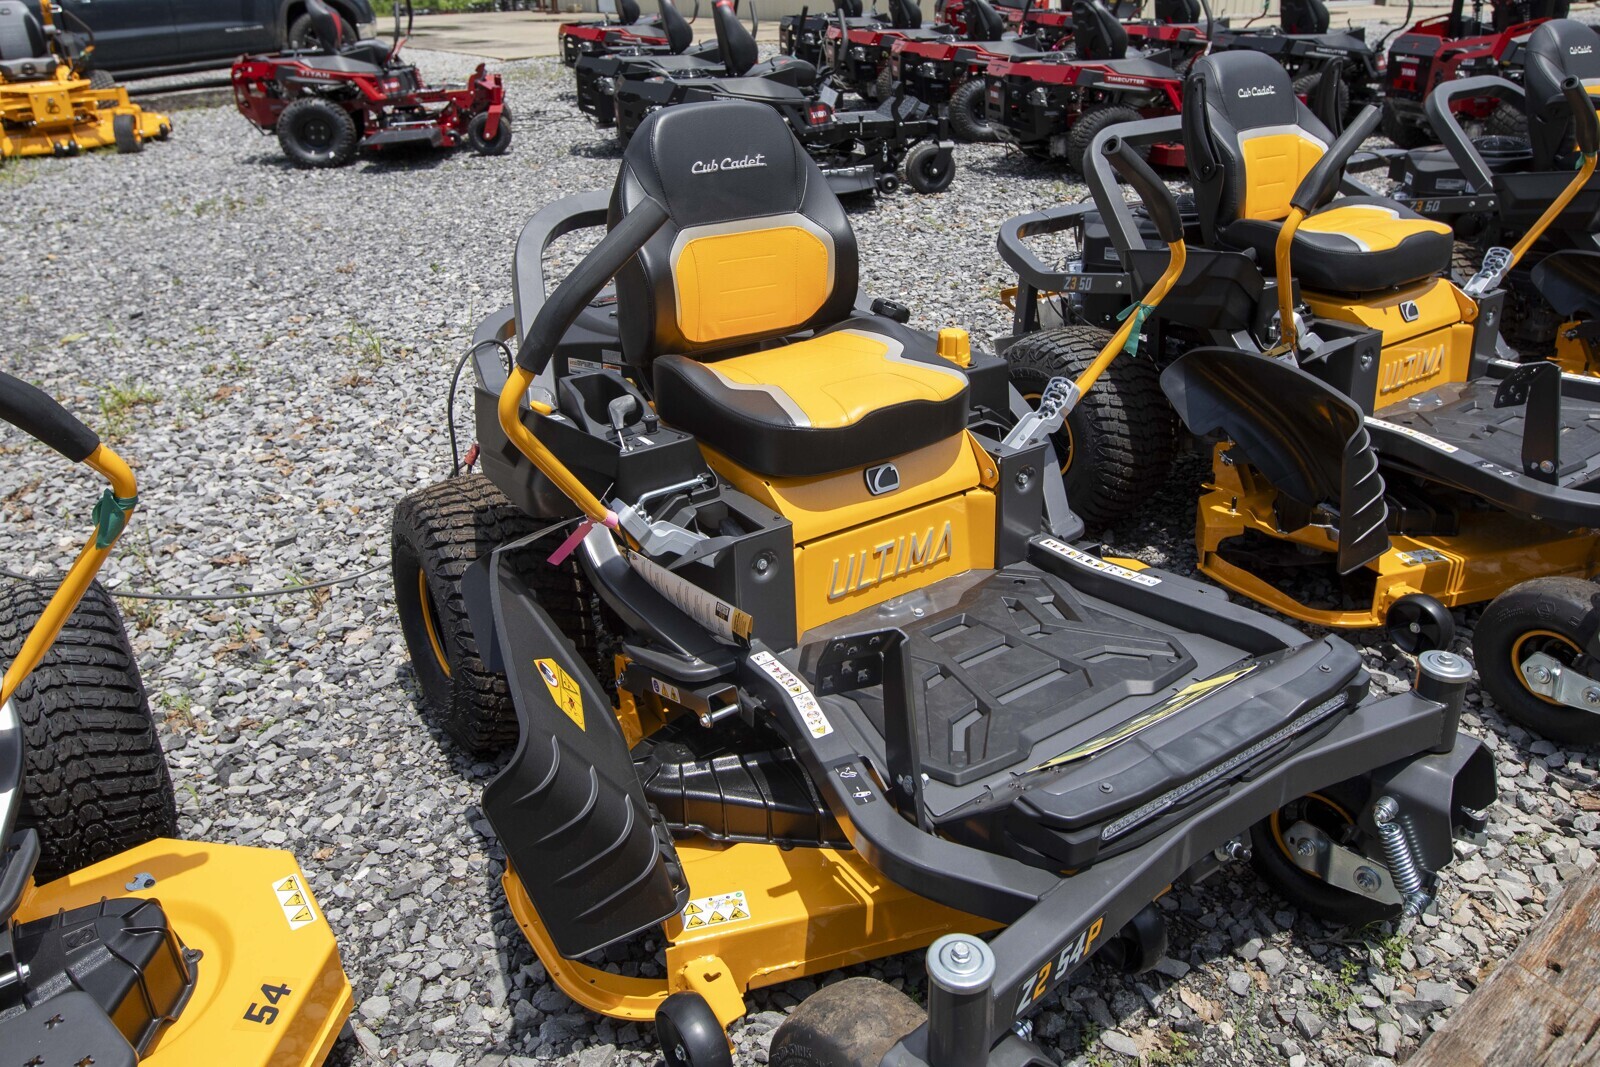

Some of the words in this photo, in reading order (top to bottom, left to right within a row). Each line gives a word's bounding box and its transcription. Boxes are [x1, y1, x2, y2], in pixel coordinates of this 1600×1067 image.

[300, 70, 330, 79] TITAN
[1107, 76, 1146, 85] TIMECUTTER
[1238, 87, 1251, 98] Cub
[1252, 85, 1276, 96] Cadet
[811, 110, 827, 119] TORO
[691, 159, 719, 175] Cub
[720, 153, 767, 171] Cadet
[1424, 200, 1440, 212] 50
[1063, 276, 1077, 290] Z3
[1078, 276, 1093, 290] 50
[1382, 343, 1445, 393] ULTIMA
[828, 519, 953, 601] ULTIMA
[1016, 961, 1053, 1016] Z2
[1054, 917, 1104, 980] 54P
[242, 983, 292, 1025] 54
